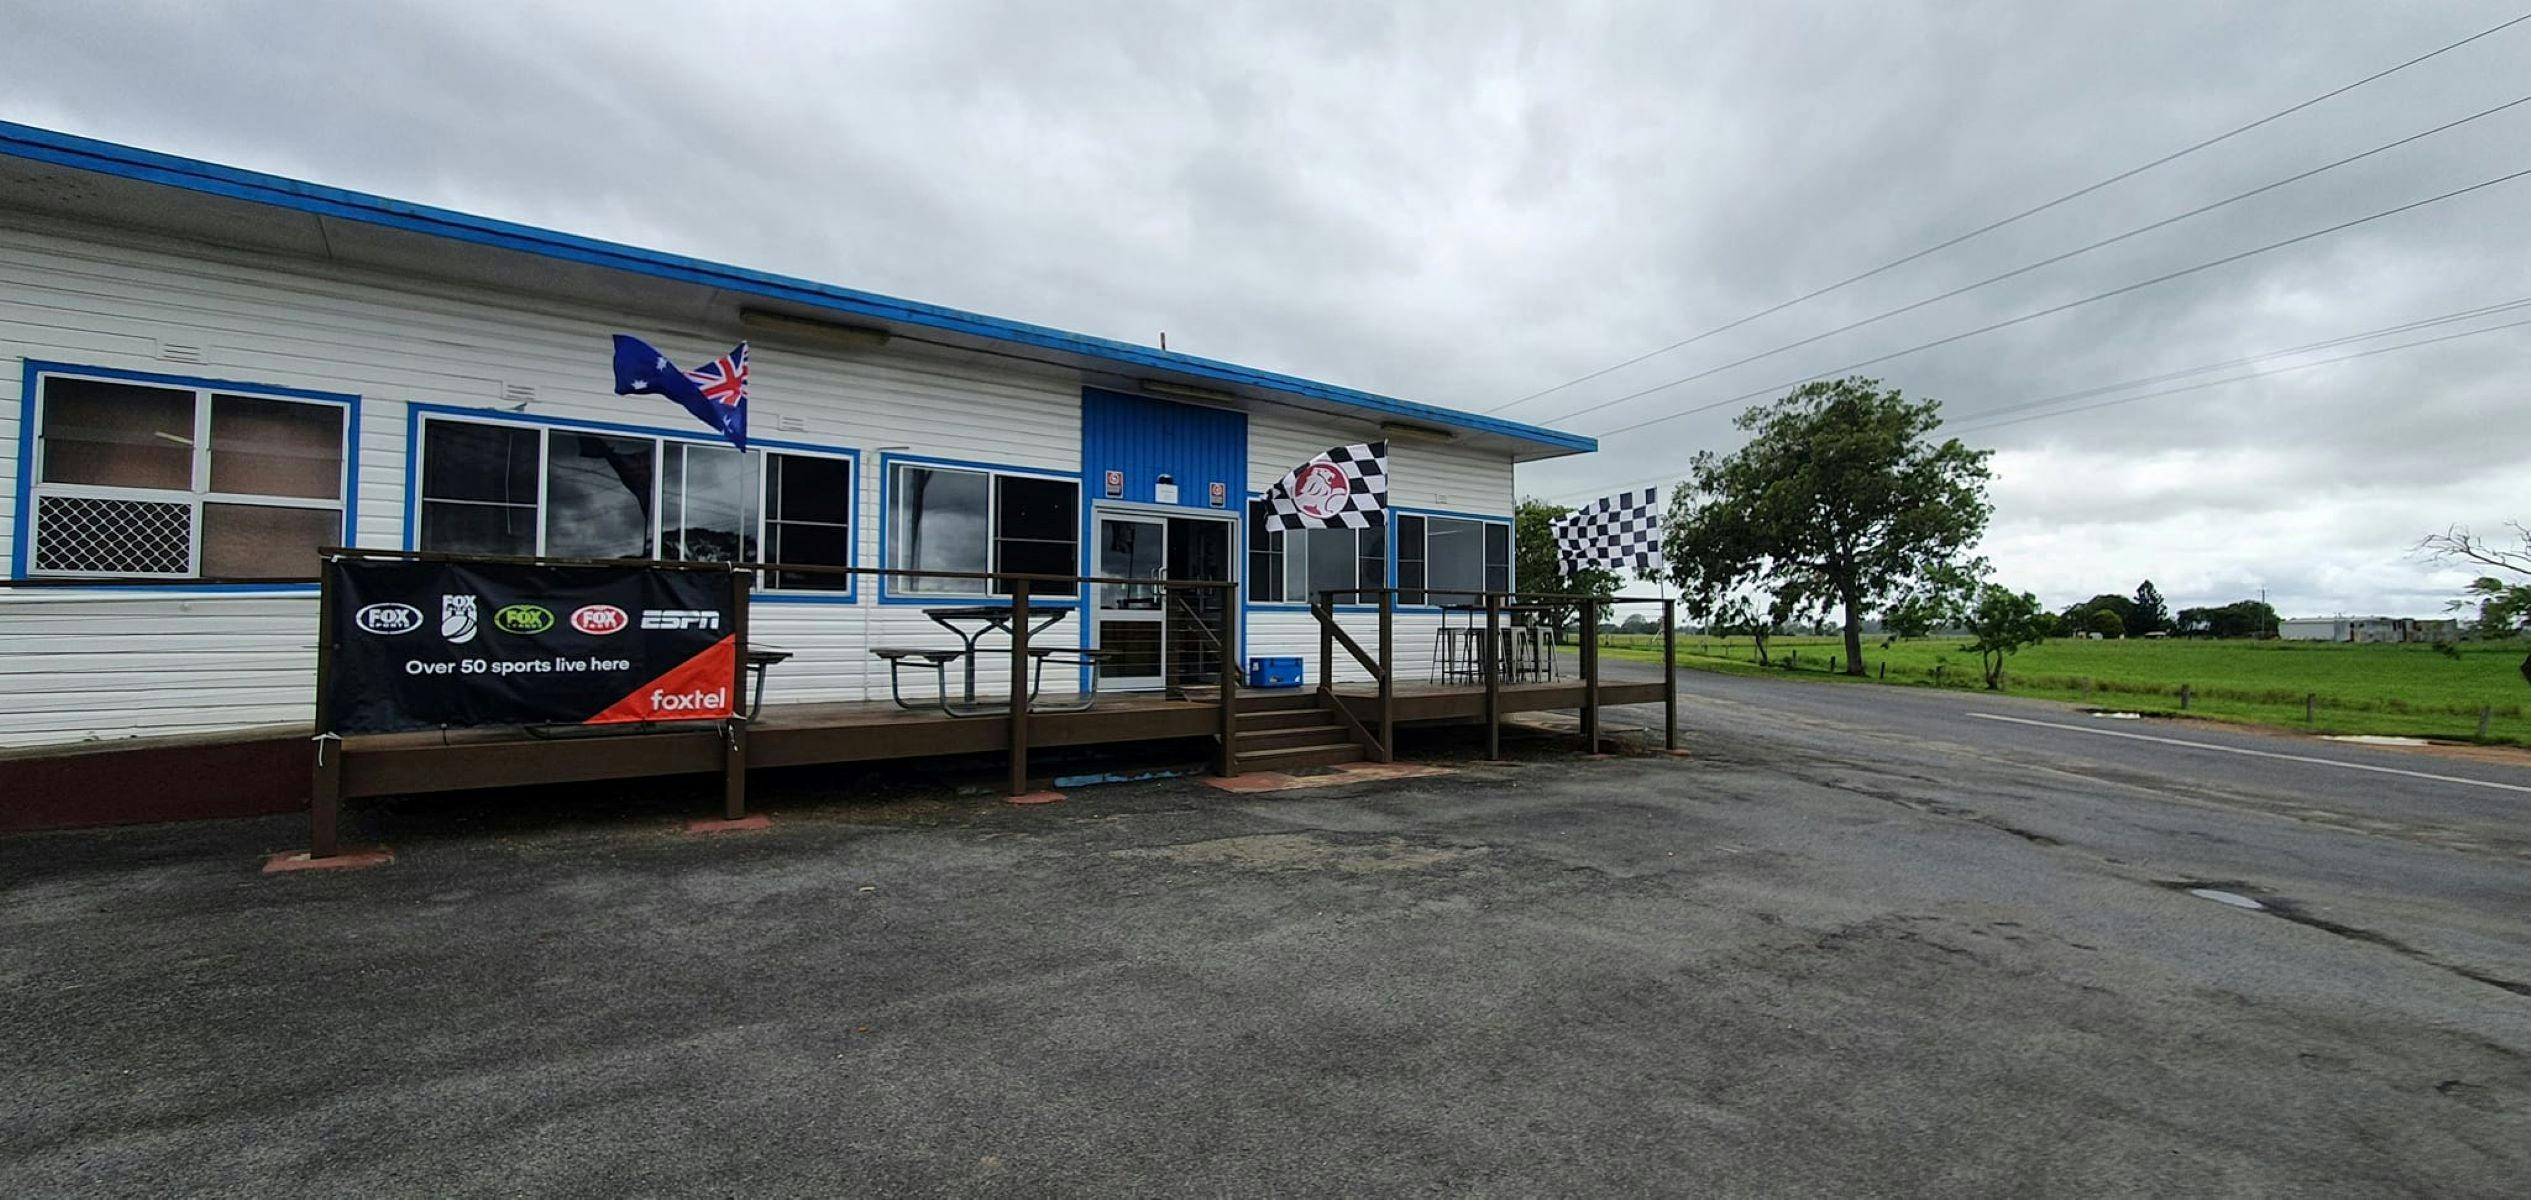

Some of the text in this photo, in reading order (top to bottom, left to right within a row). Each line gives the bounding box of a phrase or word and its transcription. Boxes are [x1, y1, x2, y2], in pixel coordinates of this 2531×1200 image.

[442, 594, 476, 608] FOX
[368, 608, 410, 623] FOX
[506, 610, 542, 624] FOX
[582, 610, 616, 625] FOX
[640, 609, 720, 630] ESPN
[405, 656, 630, 676] Over 50 sports live here
[651, 686, 726, 711] foxtel
